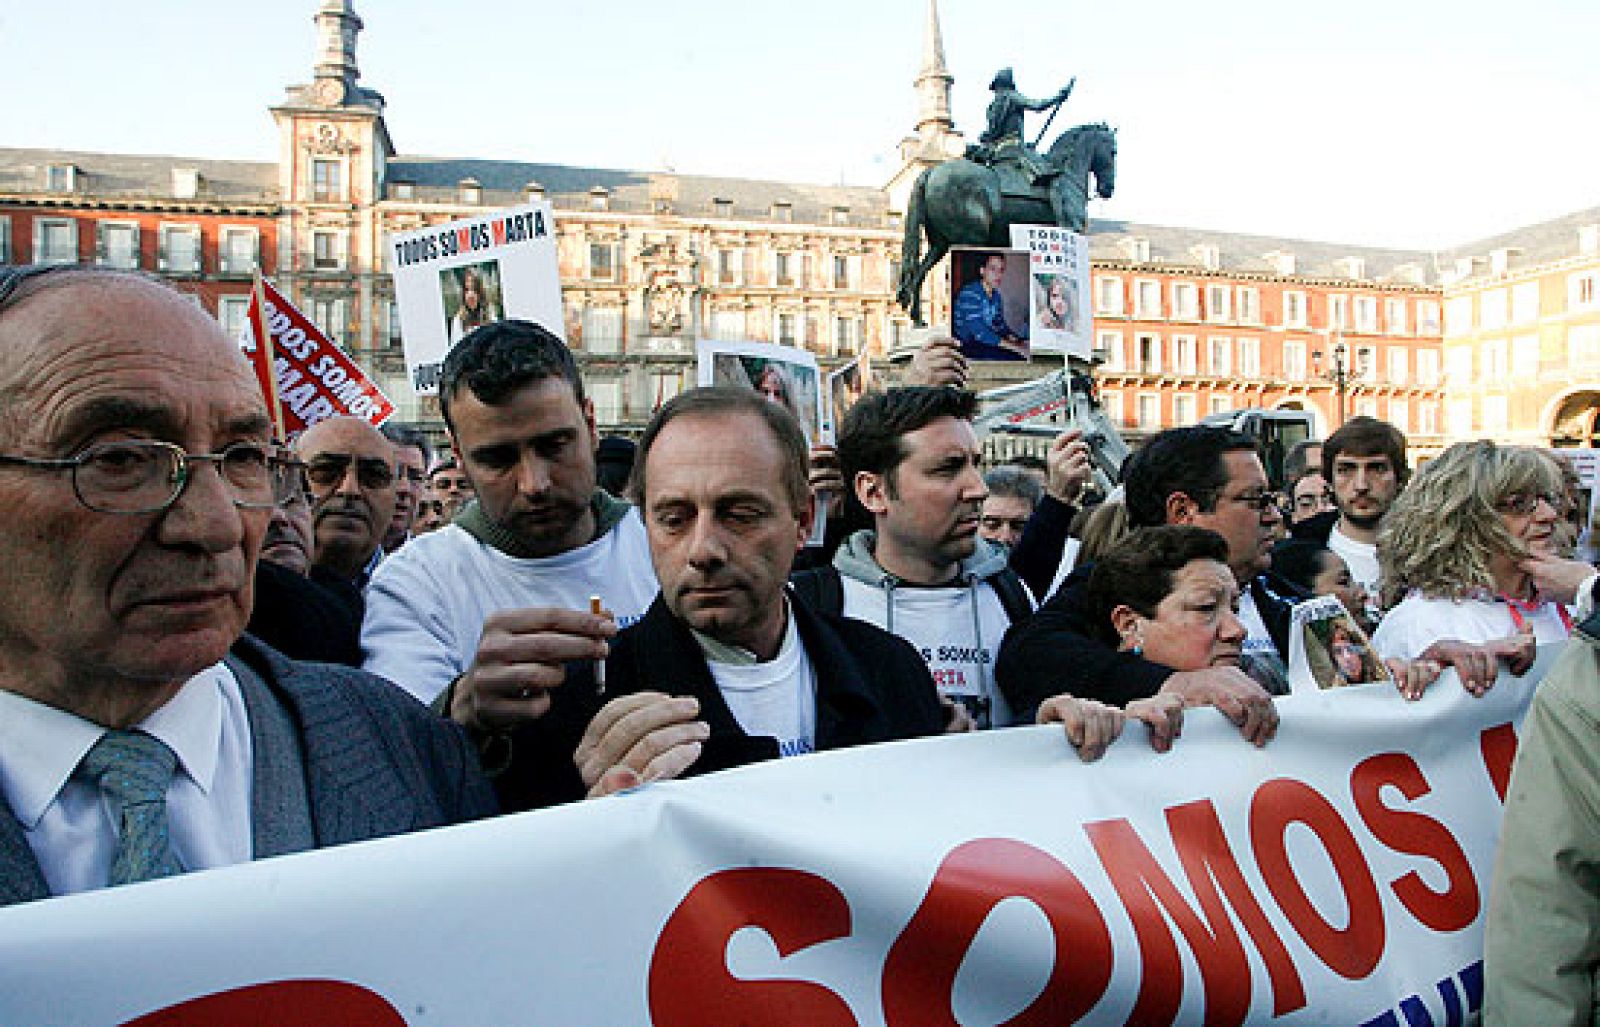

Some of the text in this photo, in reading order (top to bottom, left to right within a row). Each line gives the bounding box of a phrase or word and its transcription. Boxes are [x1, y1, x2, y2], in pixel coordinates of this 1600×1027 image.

[439, 223, 490, 257] SOMOS
[491, 209, 548, 247] MARTA
[307, 354, 382, 421] SOMOS
[648, 752, 1481, 1027] SOMOS
